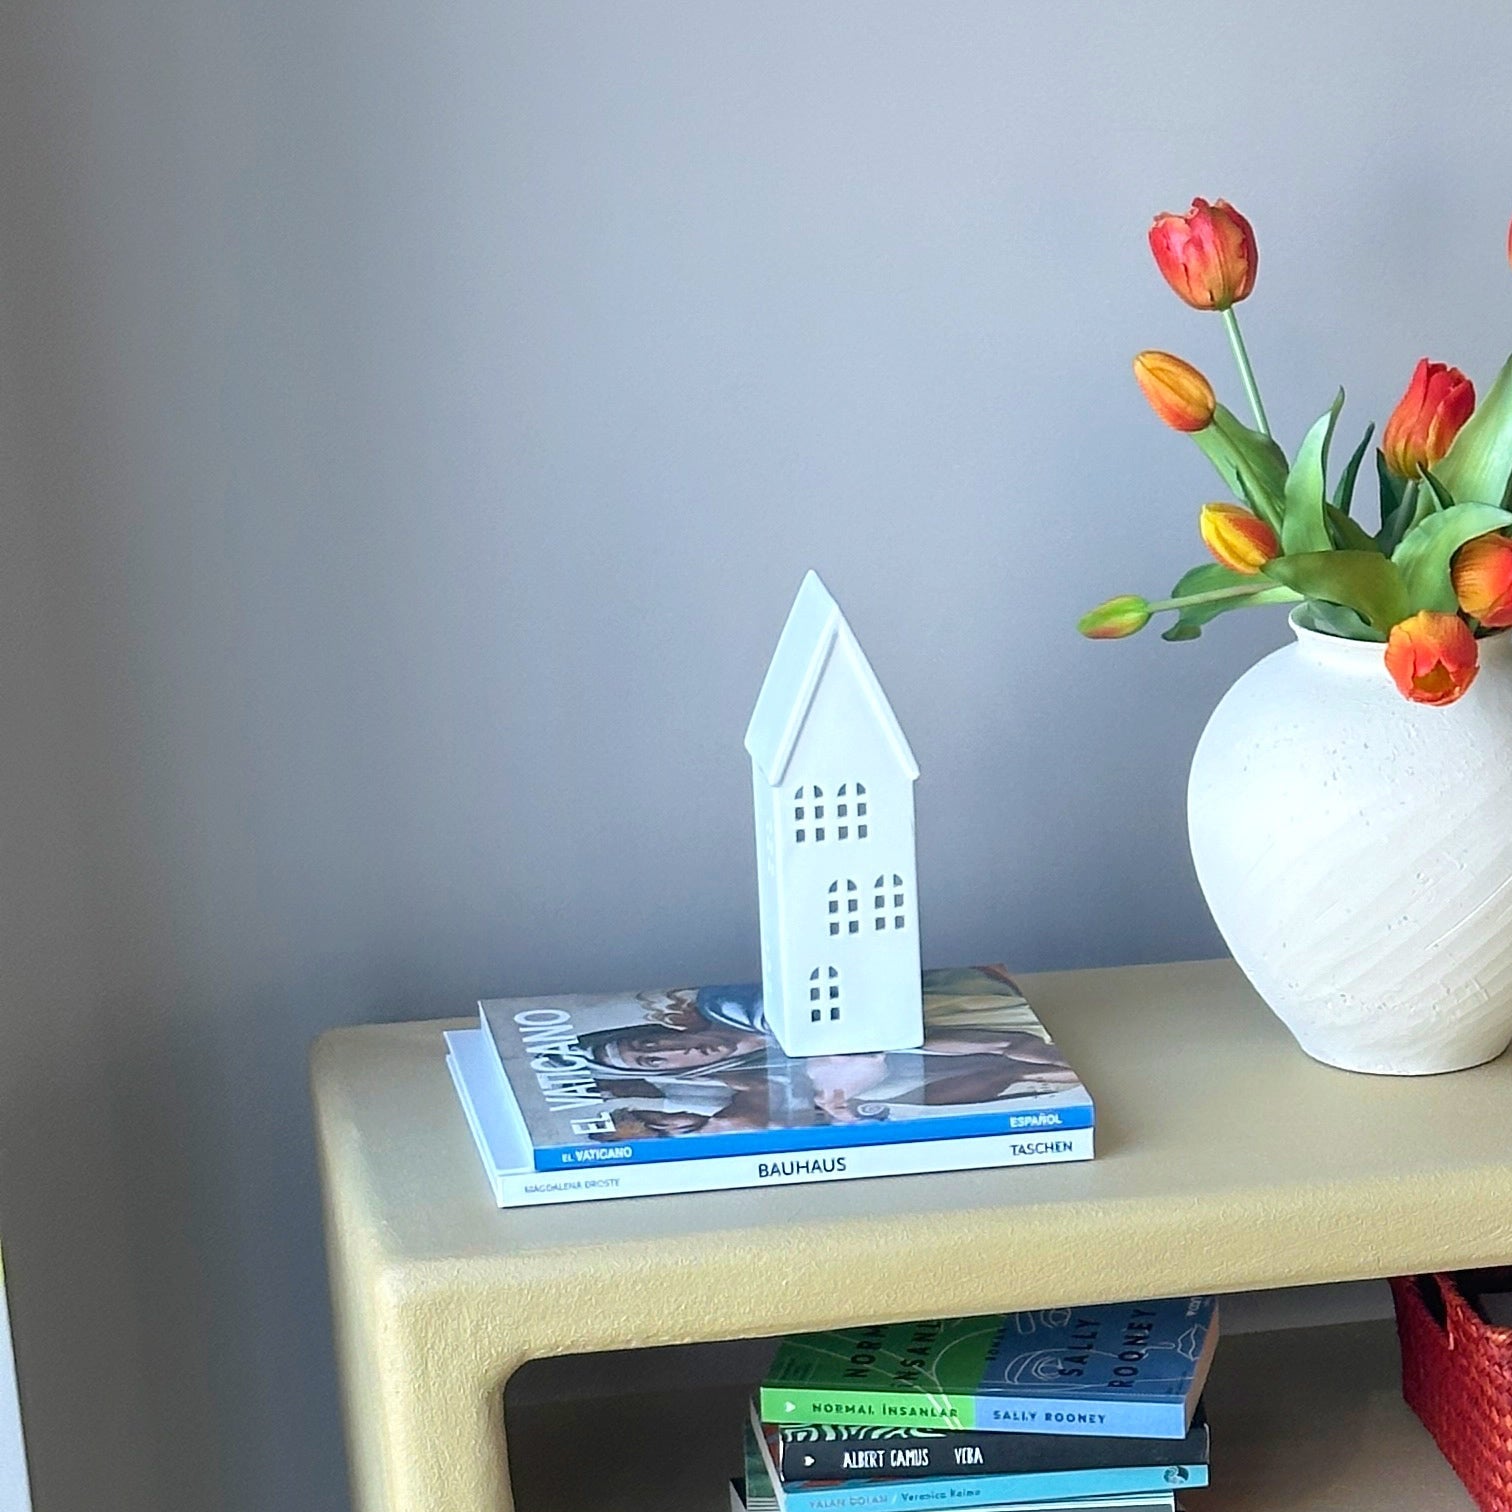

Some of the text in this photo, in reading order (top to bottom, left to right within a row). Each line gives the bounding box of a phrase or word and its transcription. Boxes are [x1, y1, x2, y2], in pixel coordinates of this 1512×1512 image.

[513, 1009, 616, 1135] EL VATICANO
[1009, 1112, 1063, 1129] ESPAÑOL
[561, 1146, 633, 1163] EL VATICANO
[1009, 1140, 1073, 1156] TASCHEN
[758, 1156, 847, 1178] BAUHAUS
[584, 1178, 620, 1190] DROSTE
[843, 1324, 888, 1378] NORM
[1057, 1307, 1157, 1389] SALLY ROONEY
[812, 1403, 958, 1417] NORMAL İNSANLAR
[992, 1409, 1106, 1425] SALLY ROONEY
[843, 1450, 886, 1469] ALBERT
[890, 1448, 929, 1467] CAMUS
